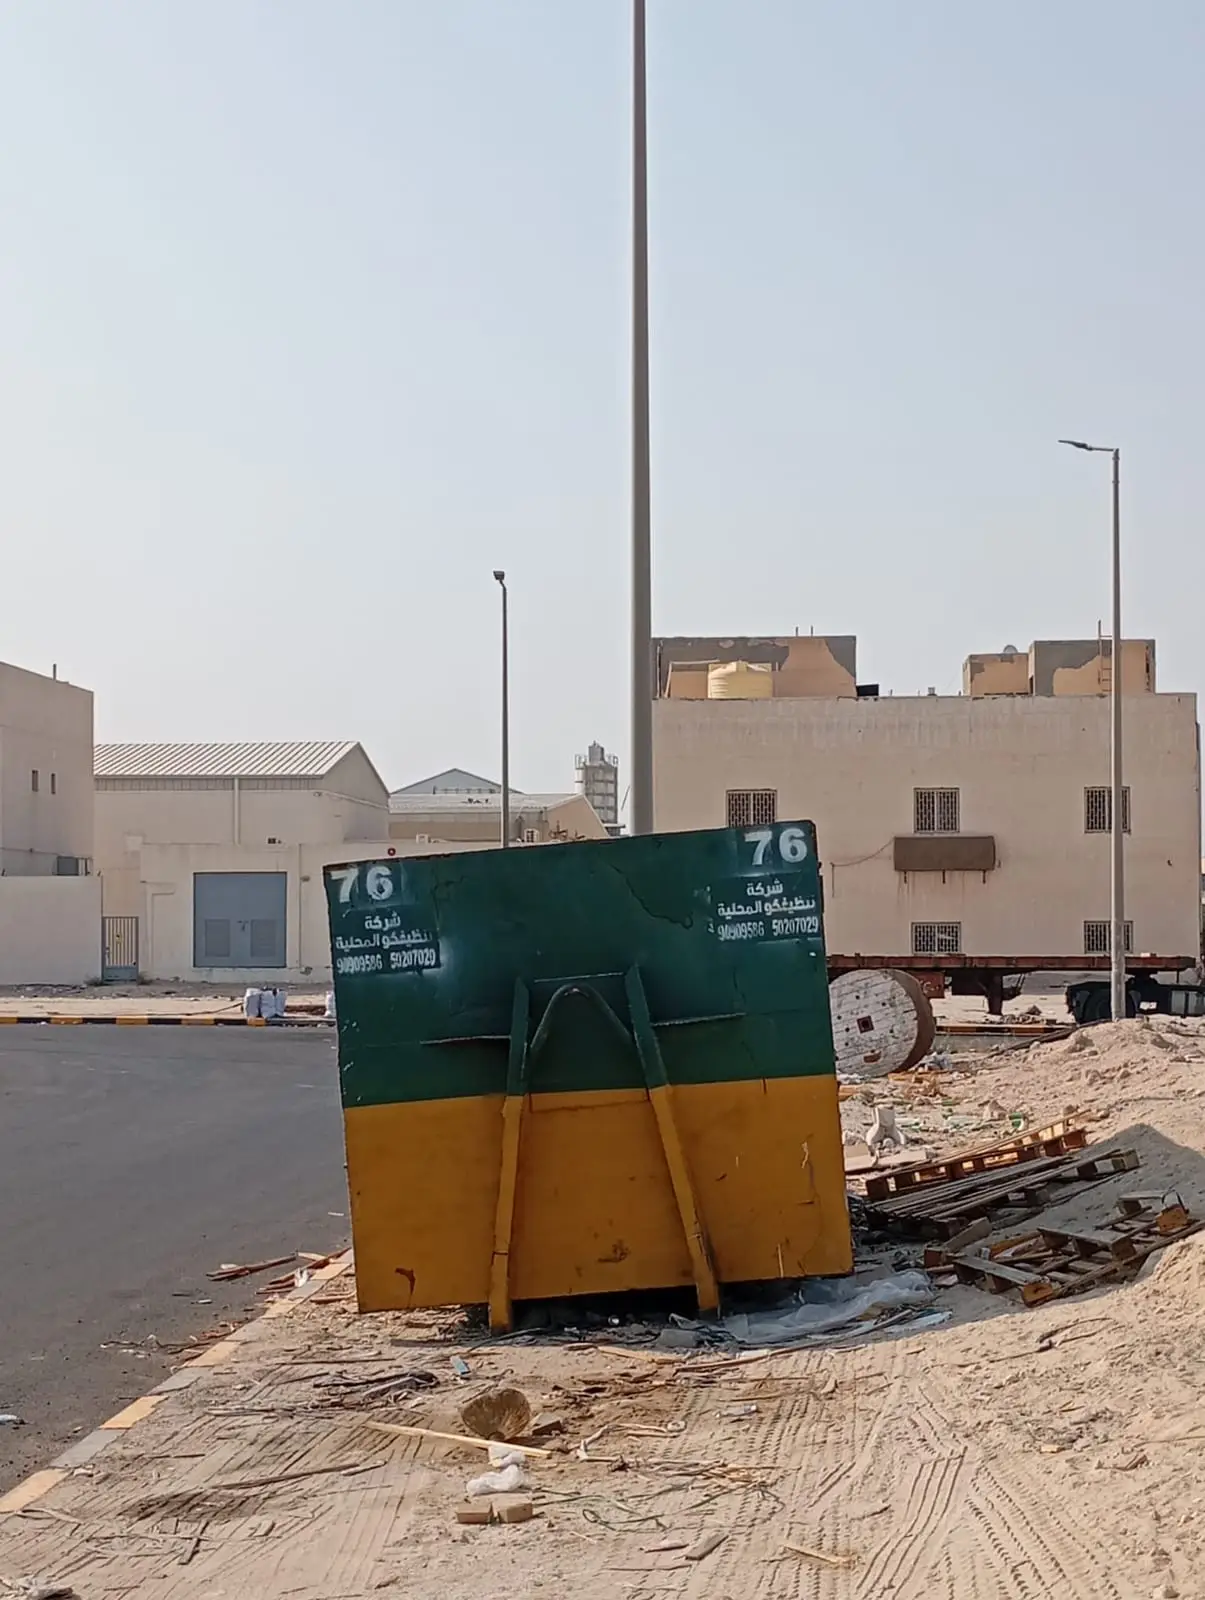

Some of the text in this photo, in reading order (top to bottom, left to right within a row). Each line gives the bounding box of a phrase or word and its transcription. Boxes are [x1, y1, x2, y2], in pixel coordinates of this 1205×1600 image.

[745, 828, 808, 865] 76
[331, 867, 394, 903] 76
[747, 878, 783, 897] شركة
[718, 899, 763, 919] المحلية
[364, 911, 401, 931] شركة
[771, 915, 819, 936] 50207029
[336, 933, 380, 952] المحلية
